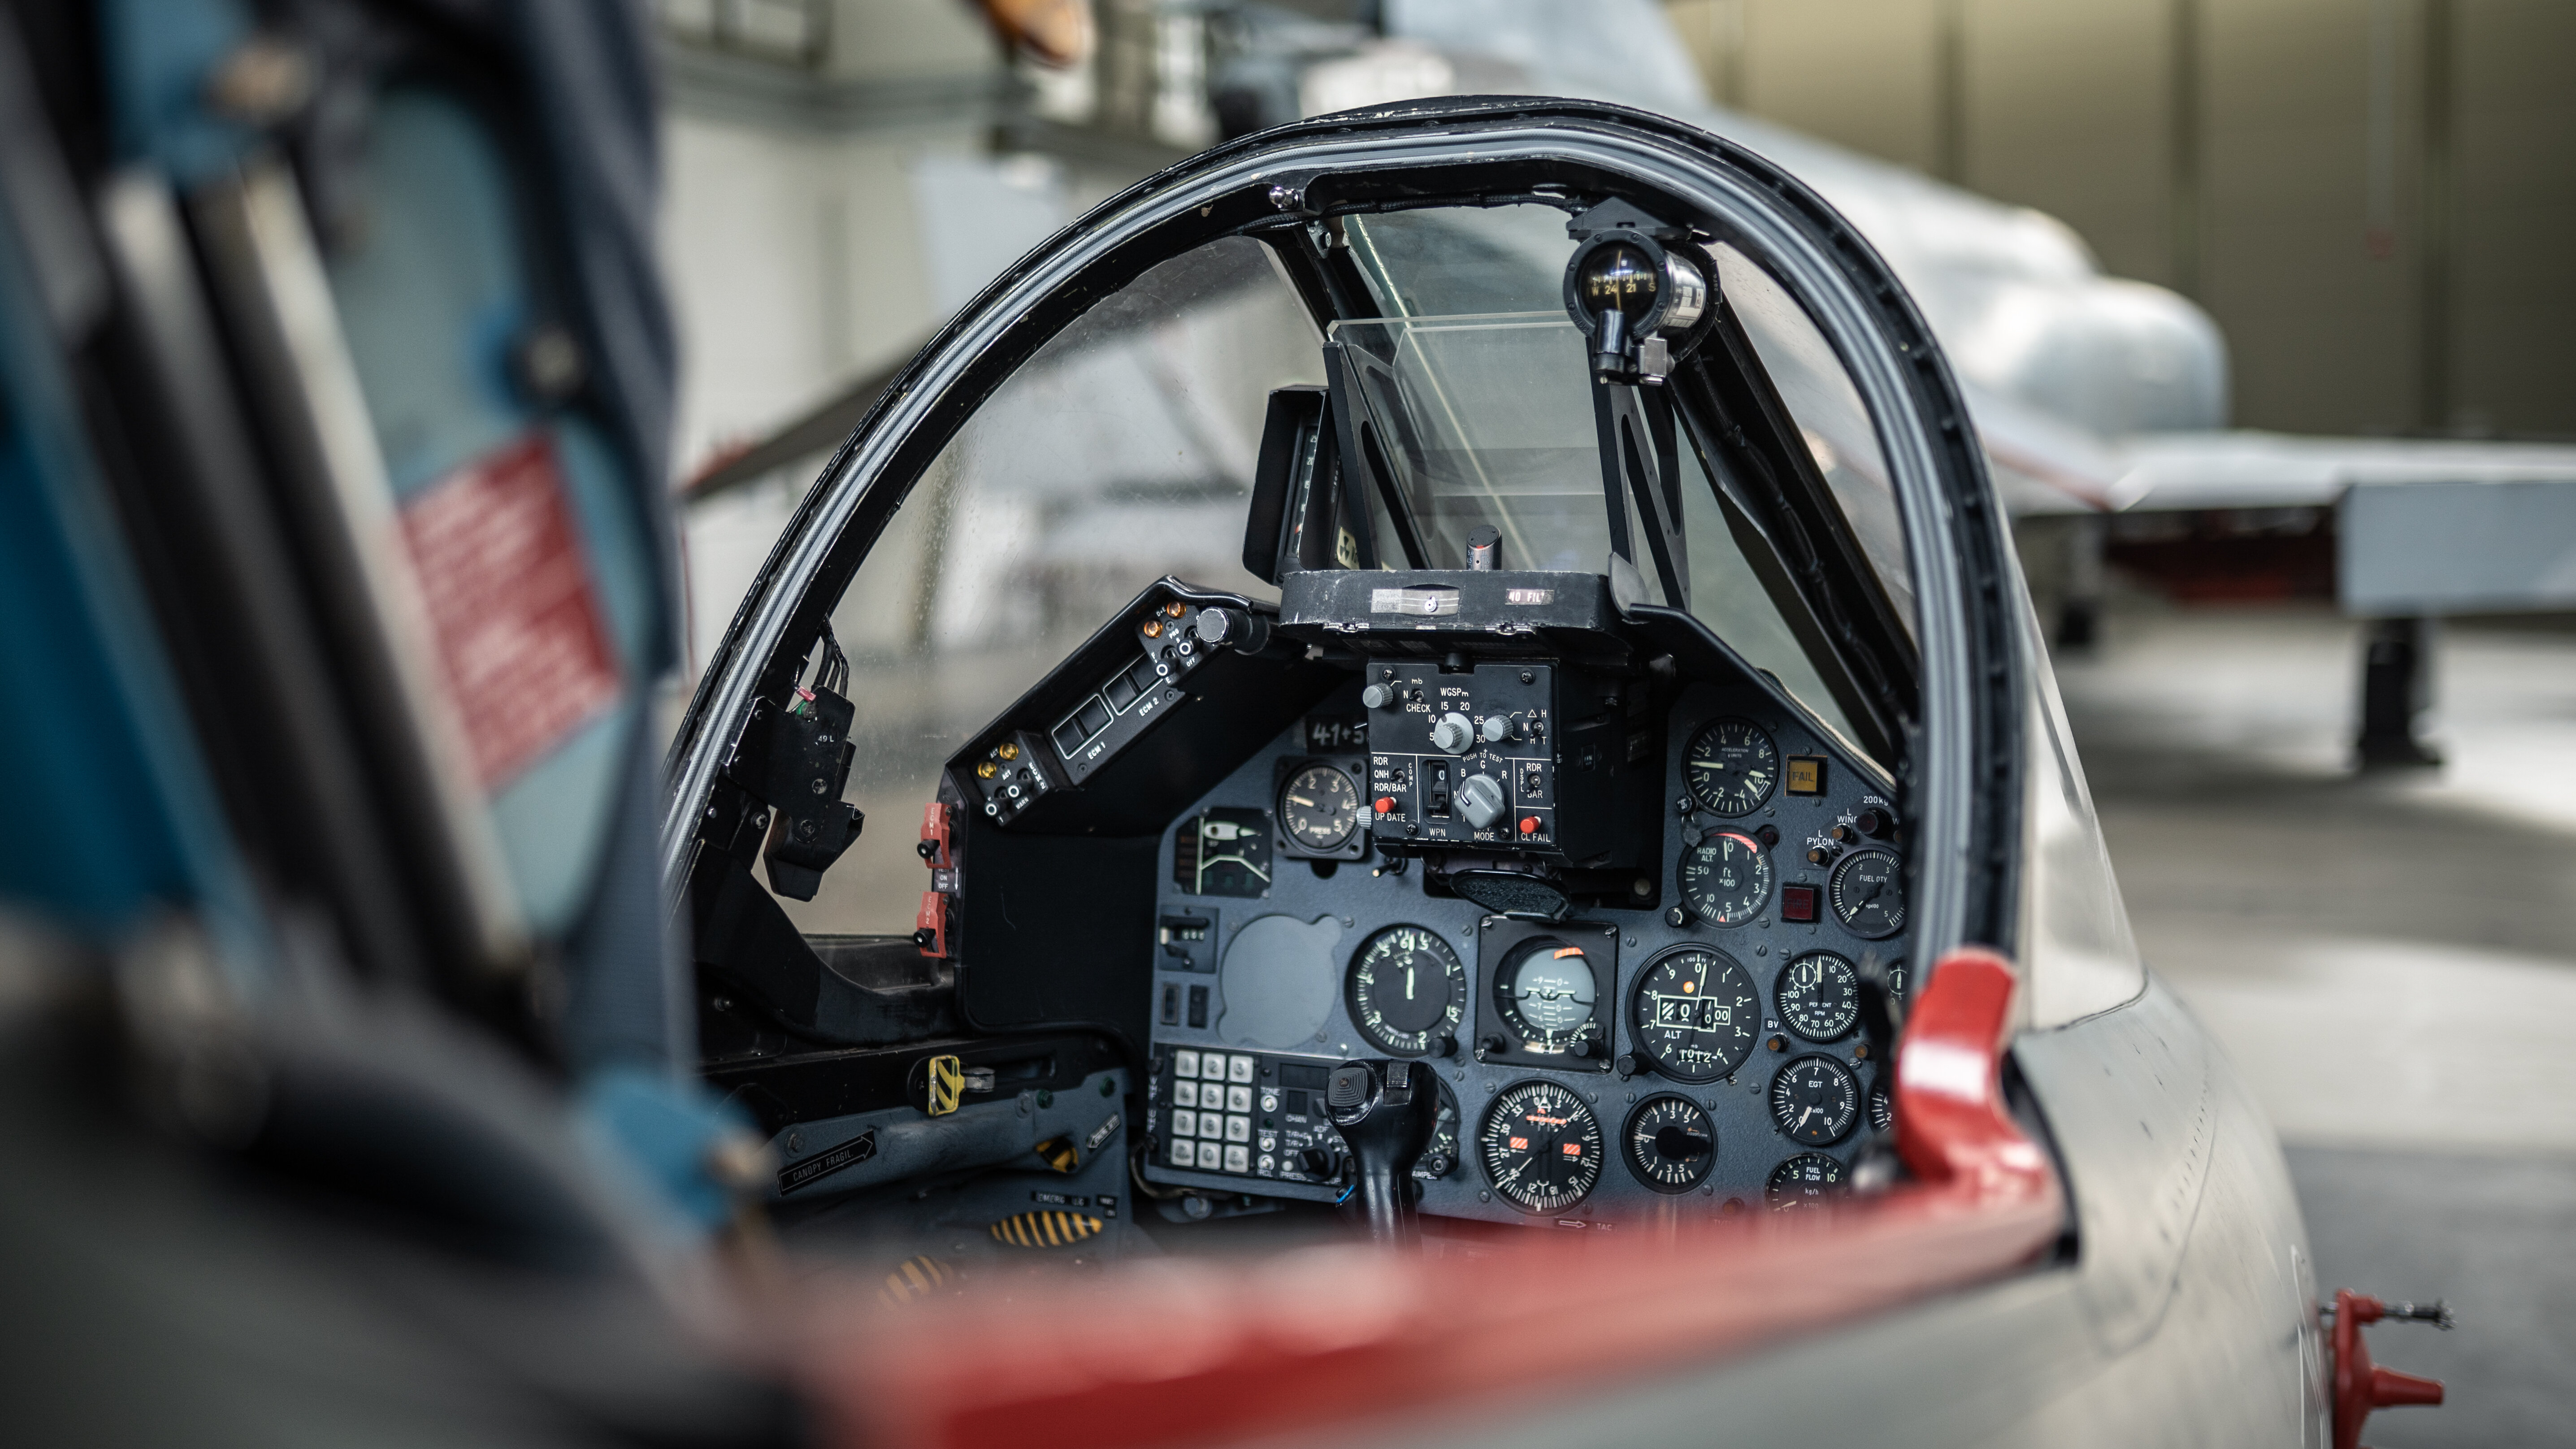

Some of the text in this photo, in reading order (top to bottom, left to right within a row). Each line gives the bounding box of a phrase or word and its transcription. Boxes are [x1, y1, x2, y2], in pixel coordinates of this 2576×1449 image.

[1592, 282, 1657, 296] W 24 21 S
[1509, 592, 1545, 603] NO FIL
[1156, 606, 1167, 618] D+E
[1186, 657, 1196, 668] OFF
[1403, 690, 1408, 699] N
[1440, 688, 1469, 697] WGSPm
[1138, 697, 1159, 717] ECM 2
[1406, 704, 1431, 713] CHECK
[1441, 702, 1470, 711] 15 20
[1428, 715, 1436, 723] 10
[1474, 716, 1484, 724] 25
[1523, 723, 1529, 731] N
[1429, 733, 1434, 741] 5
[1476, 735, 1486, 743] 30
[1721, 735, 1726, 745] 4
[1744, 736, 1751, 746] 6
[989, 747, 1000, 759] ACT
[1087, 745, 1102, 760] ECM
[1704, 747, 1711, 757] 2
[1758, 749, 1765, 759] 8
[1373, 756, 1388, 766] RDR
[1462, 753, 1477, 763] PUSH
[1489, 753, 1503, 764] TEST
[1480, 760, 1486, 769] G
[1527, 763, 1542, 772] RDR
[1001, 768, 1012, 781] ACT
[1374, 770, 1389, 779] QNH
[1461, 768, 1466, 777] B
[1502, 770, 1507, 779] R
[1703, 772, 1710, 782] 0
[1792, 771, 1815, 782] FAIL
[1308, 777, 1316, 790] 2
[1374, 782, 1407, 793] RDR/BAR
[1527, 790, 1543, 798] BAR
[1713, 787, 1724, 798] -2
[1734, 789, 1745, 798] -4
[1015, 796, 1030, 810] WARN
[1847, 808, 1852, 816] L
[1375, 812, 1406, 822] UP DATE
[1333, 819, 1342, 832] 5
[1429, 828, 1446, 837] WPN
[1474, 832, 1494, 841] MODE
[1818, 829, 1823, 837] L
[1521, 833, 1551, 842] CL FAIL
[1807, 837, 1834, 846] PYLON
[1697, 847, 1717, 855] RADIO
[1727, 842, 1734, 852] 0
[1698, 866, 1709, 875] 50
[1723, 867, 1731, 877] ft
[1755, 865, 1761, 875] 2
[1753, 883, 1760, 894] 3
[1707, 894, 1715, 903] 10
[1743, 896, 1750, 907] 4
[1726, 902, 1731, 912] 5
[1786, 898, 1810, 910] FIRE
[1695, 963, 1702, 973] 0
[1829, 966, 1836, 974] 10
[1669, 969, 1676, 980] 9
[1838, 975, 1847, 983] 20
[1651, 990, 1658, 1001] 8
[1787, 990, 1800, 999] 100
[1843, 988, 1852, 996] 30
[1736, 996, 1743, 1007] 2
[1791, 1003, 1800, 1011] 90
[1835, 1012, 1845, 1020] 50
[1650, 1019, 1656, 1030] 7
[1767, 1020, 1779, 1028] BV
[1811, 1020, 1820, 1028] 70
[1664, 1030, 1682, 1040] ALT
[1734, 1026, 1742, 1037] 3
[1418, 1030, 1427, 1044] 2
[1665, 1043, 1672, 1054] 6
[1716, 1047, 1723, 1058] 4
[1814, 1067, 1819, 1076] 7
[1792, 1074, 1797, 1083] 6
[1834, 1078, 1839, 1087] 8
[1786, 1088, 1791, 1097] 4
[1883, 1096, 1889, 1105] 4
[1789, 1104, 1794, 1112] 2
[1840, 1101, 1845, 1110] 9
[1670, 1111, 1676, 1119] 3
[1684, 1114, 1690, 1123] 5
[1886, 1112, 1892, 1121] 2
[1824, 1117, 1832, 1126] 10
[793, 1162, 822, 1182] CANOPY
[1666, 1164, 1673, 1173] 3
[1678, 1164, 1685, 1172] 5
[1793, 1170, 1799, 1179] 5
[1827, 1173, 1836, 1182] 10
[1805, 1188, 1819, 1196] kg/h
